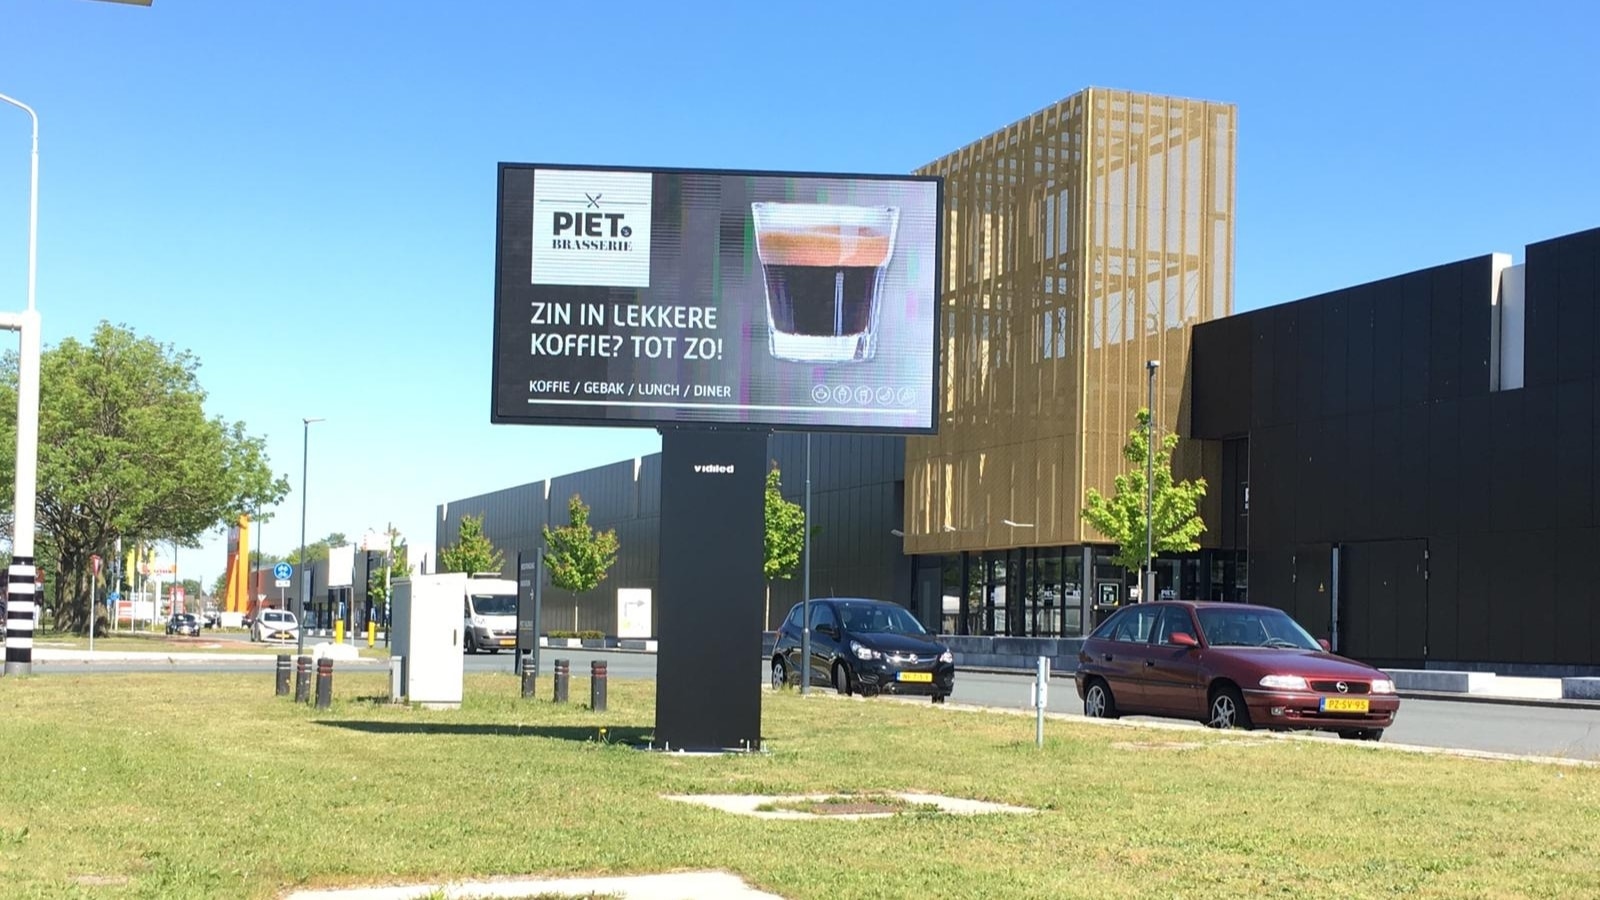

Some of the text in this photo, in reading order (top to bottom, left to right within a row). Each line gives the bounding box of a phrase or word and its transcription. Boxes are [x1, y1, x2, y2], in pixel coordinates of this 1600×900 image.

[552, 239, 632, 252] BRASSERIE
[530, 302, 717, 329] ZIN IN LEKKERE
[530, 333, 723, 360] KOFFIE? TOT ZO!
[529, 380, 731, 397] KOFFIE / GEBAK / LUNCH / DINER
[1329, 700, 1367, 710] PZ-SV-95
